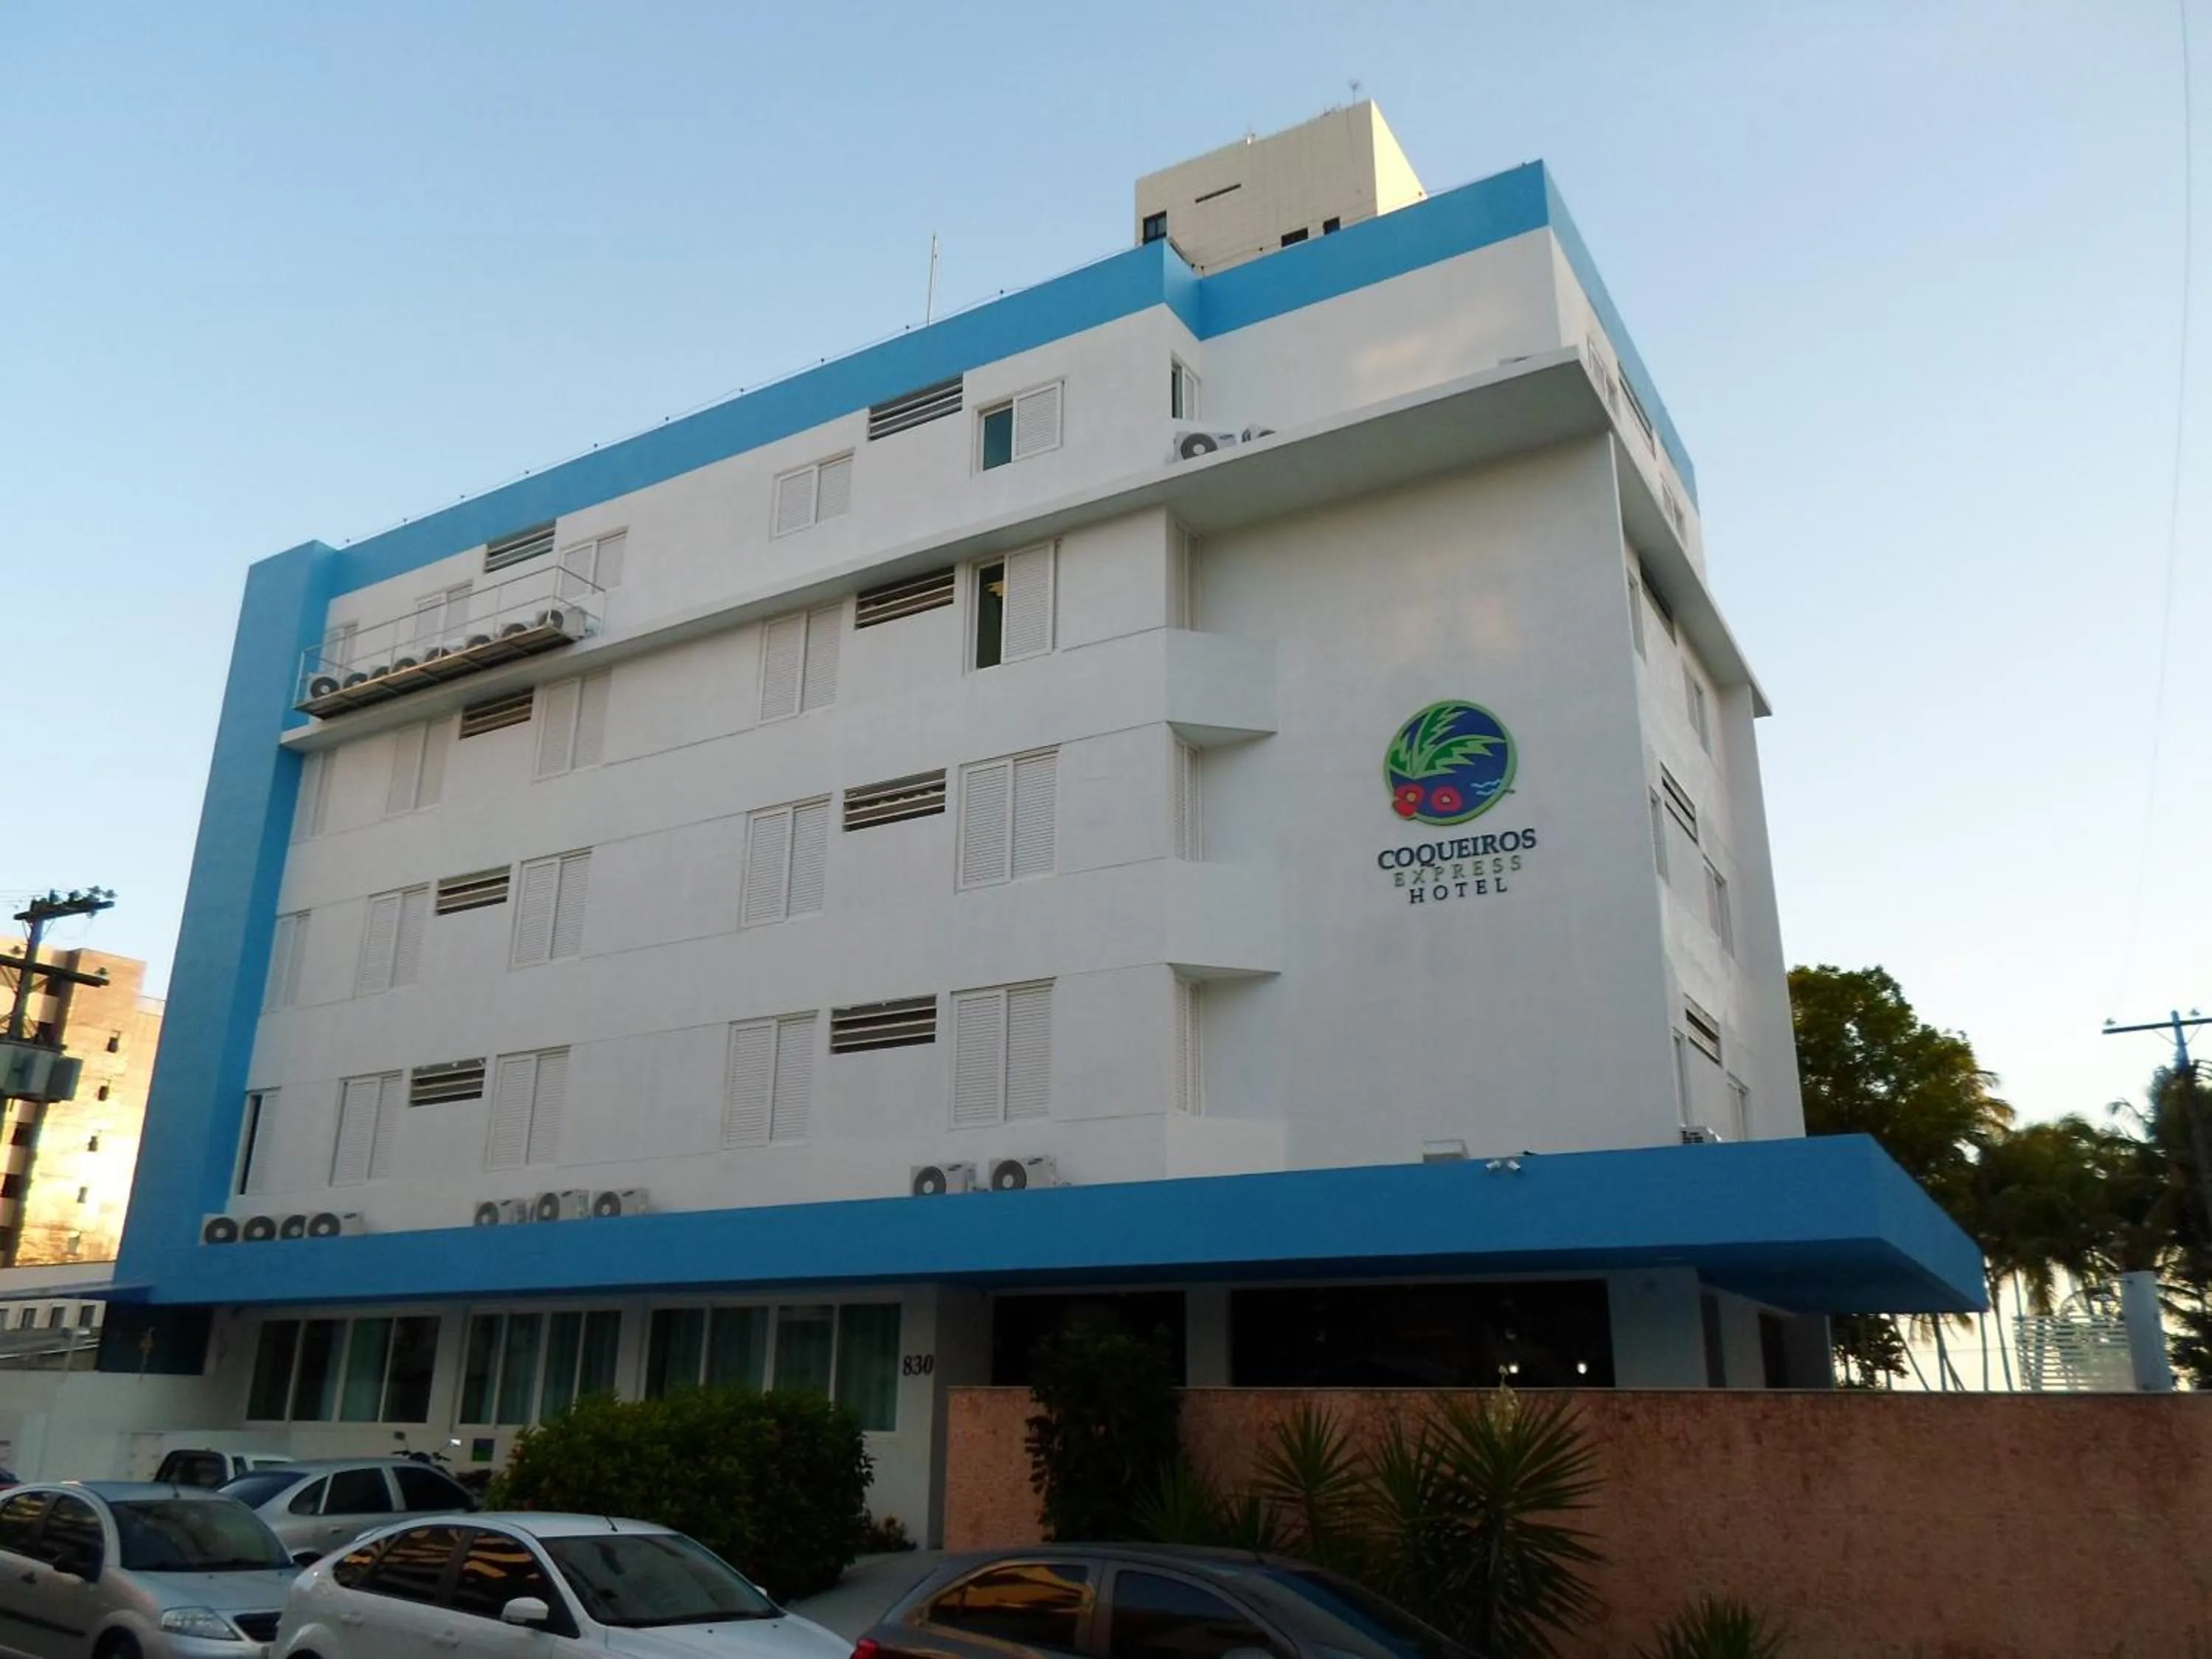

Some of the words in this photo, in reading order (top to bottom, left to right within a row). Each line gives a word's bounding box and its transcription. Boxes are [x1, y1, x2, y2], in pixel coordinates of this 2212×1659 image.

[1377, 828, 1537, 869] COQUEIROS
[1394, 855, 1522, 887] EXPRESS
[1409, 877, 1508, 904] HOTEL
[903, 1354, 933, 1376] 830
